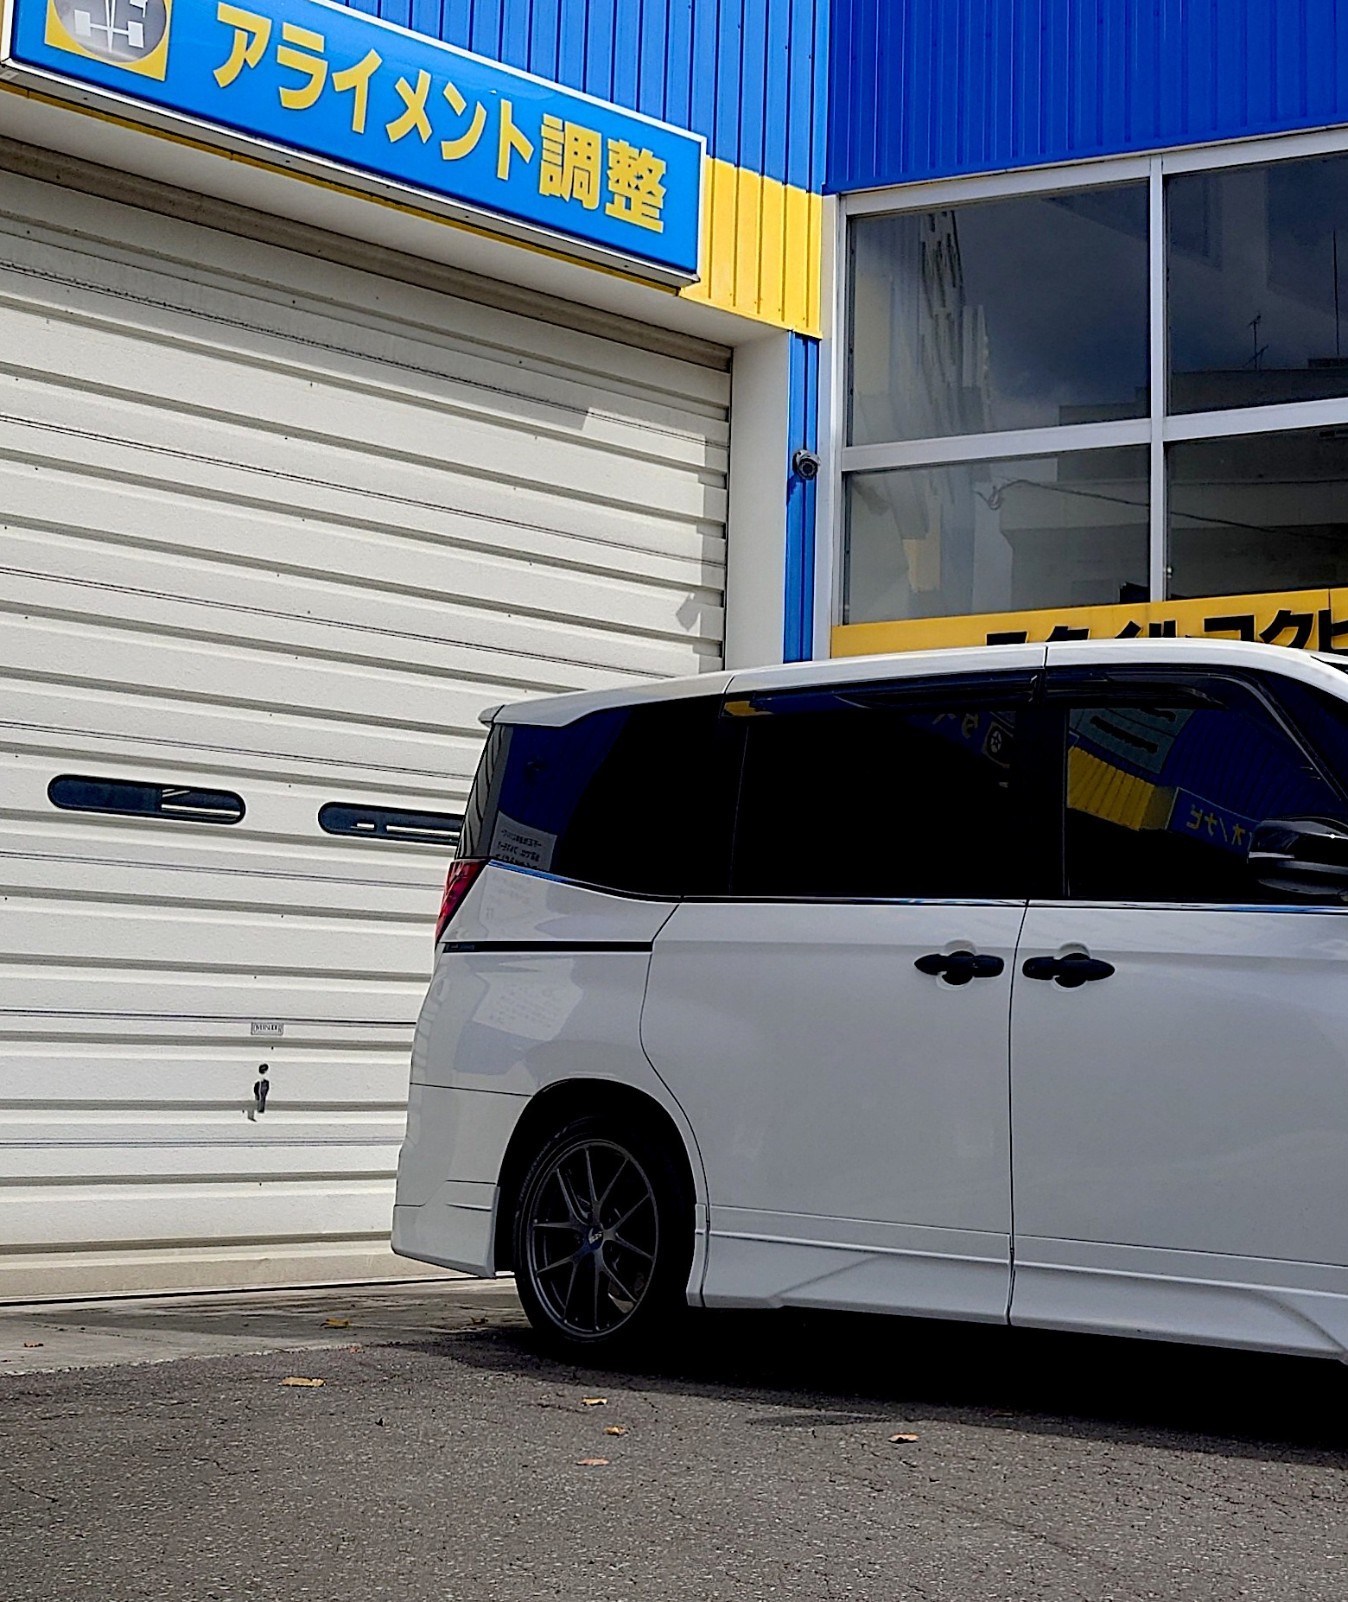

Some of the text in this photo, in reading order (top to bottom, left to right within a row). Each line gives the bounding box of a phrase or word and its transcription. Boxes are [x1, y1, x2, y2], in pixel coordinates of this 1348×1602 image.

[213, 4, 667, 233] アライメント調整
